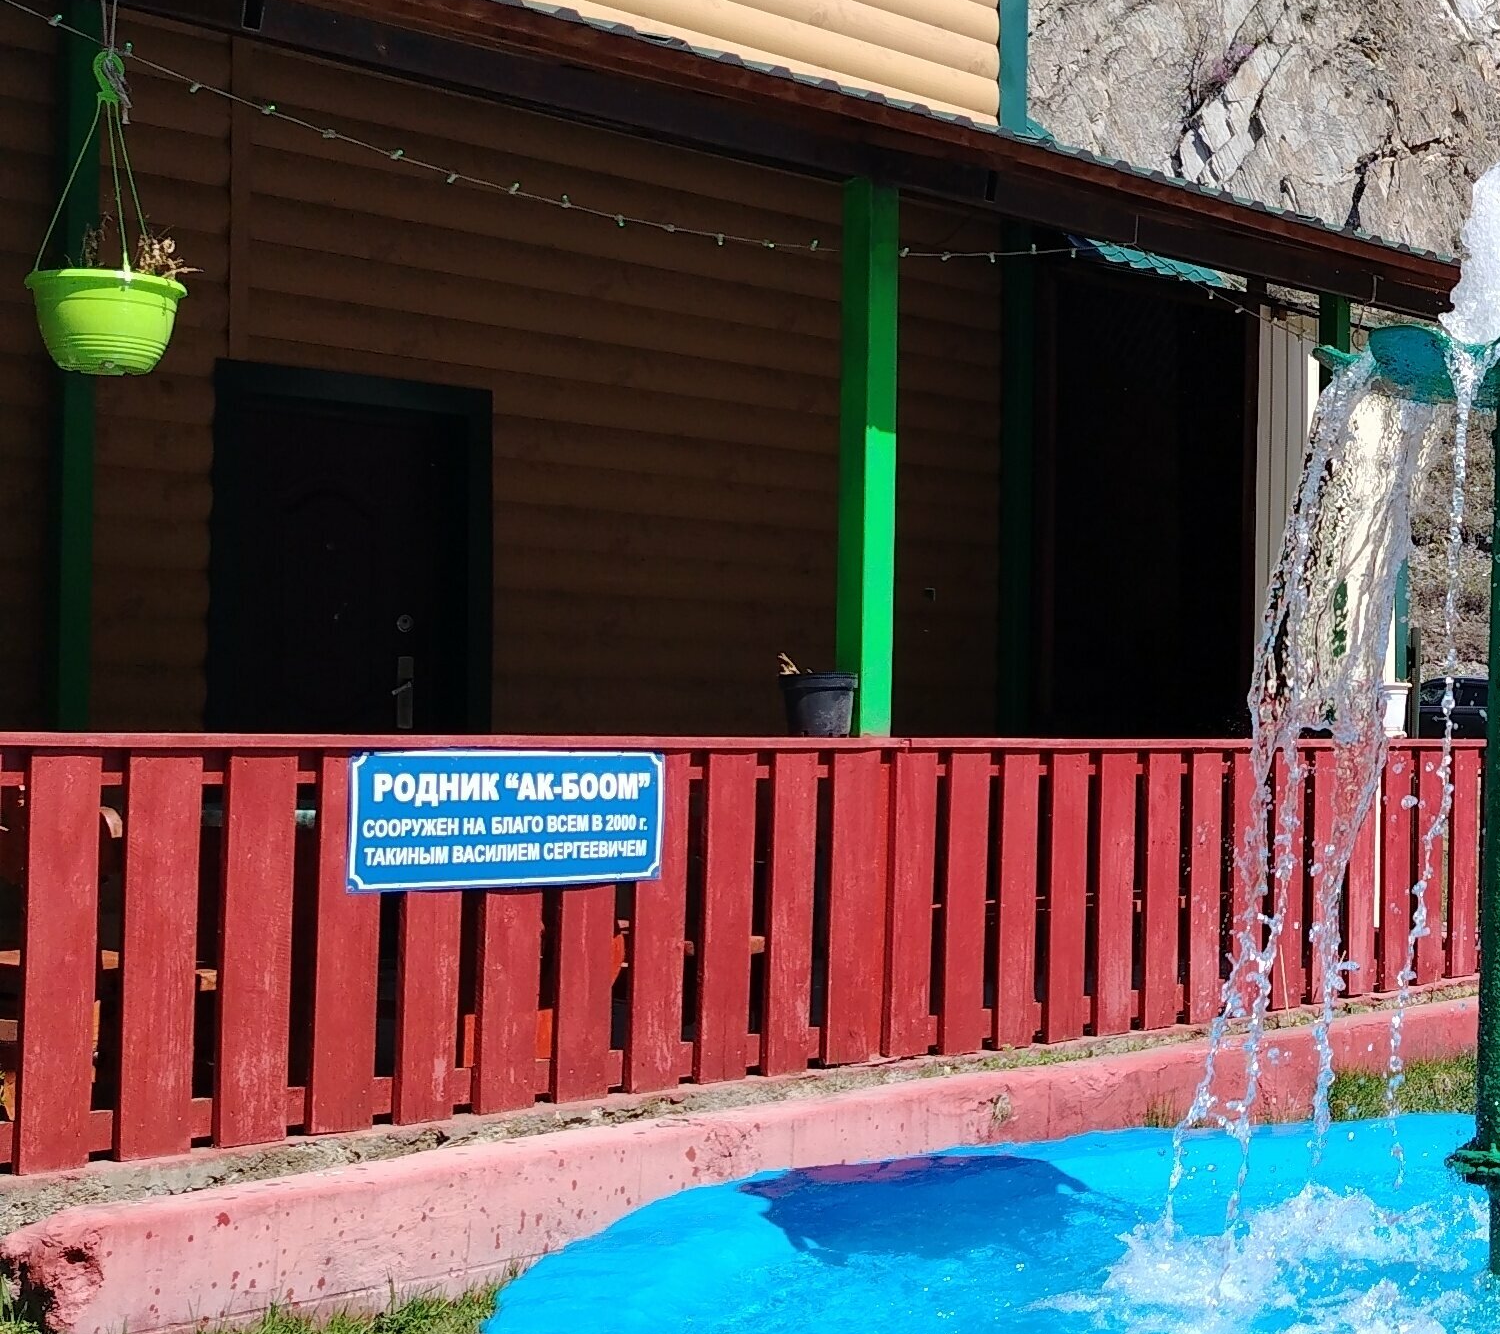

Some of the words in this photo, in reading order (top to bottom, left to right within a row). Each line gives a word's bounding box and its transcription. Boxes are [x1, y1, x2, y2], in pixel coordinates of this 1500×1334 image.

[373, 772, 500, 807] РОДНИК
[362, 817, 460, 838] СООРУЖЕН
[463, 817, 487, 835] НА
[491, 815, 544, 835] БЛАГО
[547, 814, 590, 833] ВСЕМ
[591, 814, 603, 832] В
[605, 814, 636, 831] 2000
[638, 817, 649, 831] г.
[363, 845, 449, 867] ТАКИНЫМ
[452, 842, 540, 864] ВАСИЛИЕМ
[543, 839, 648, 861] СЕРГЕЕВИЧЕМ
